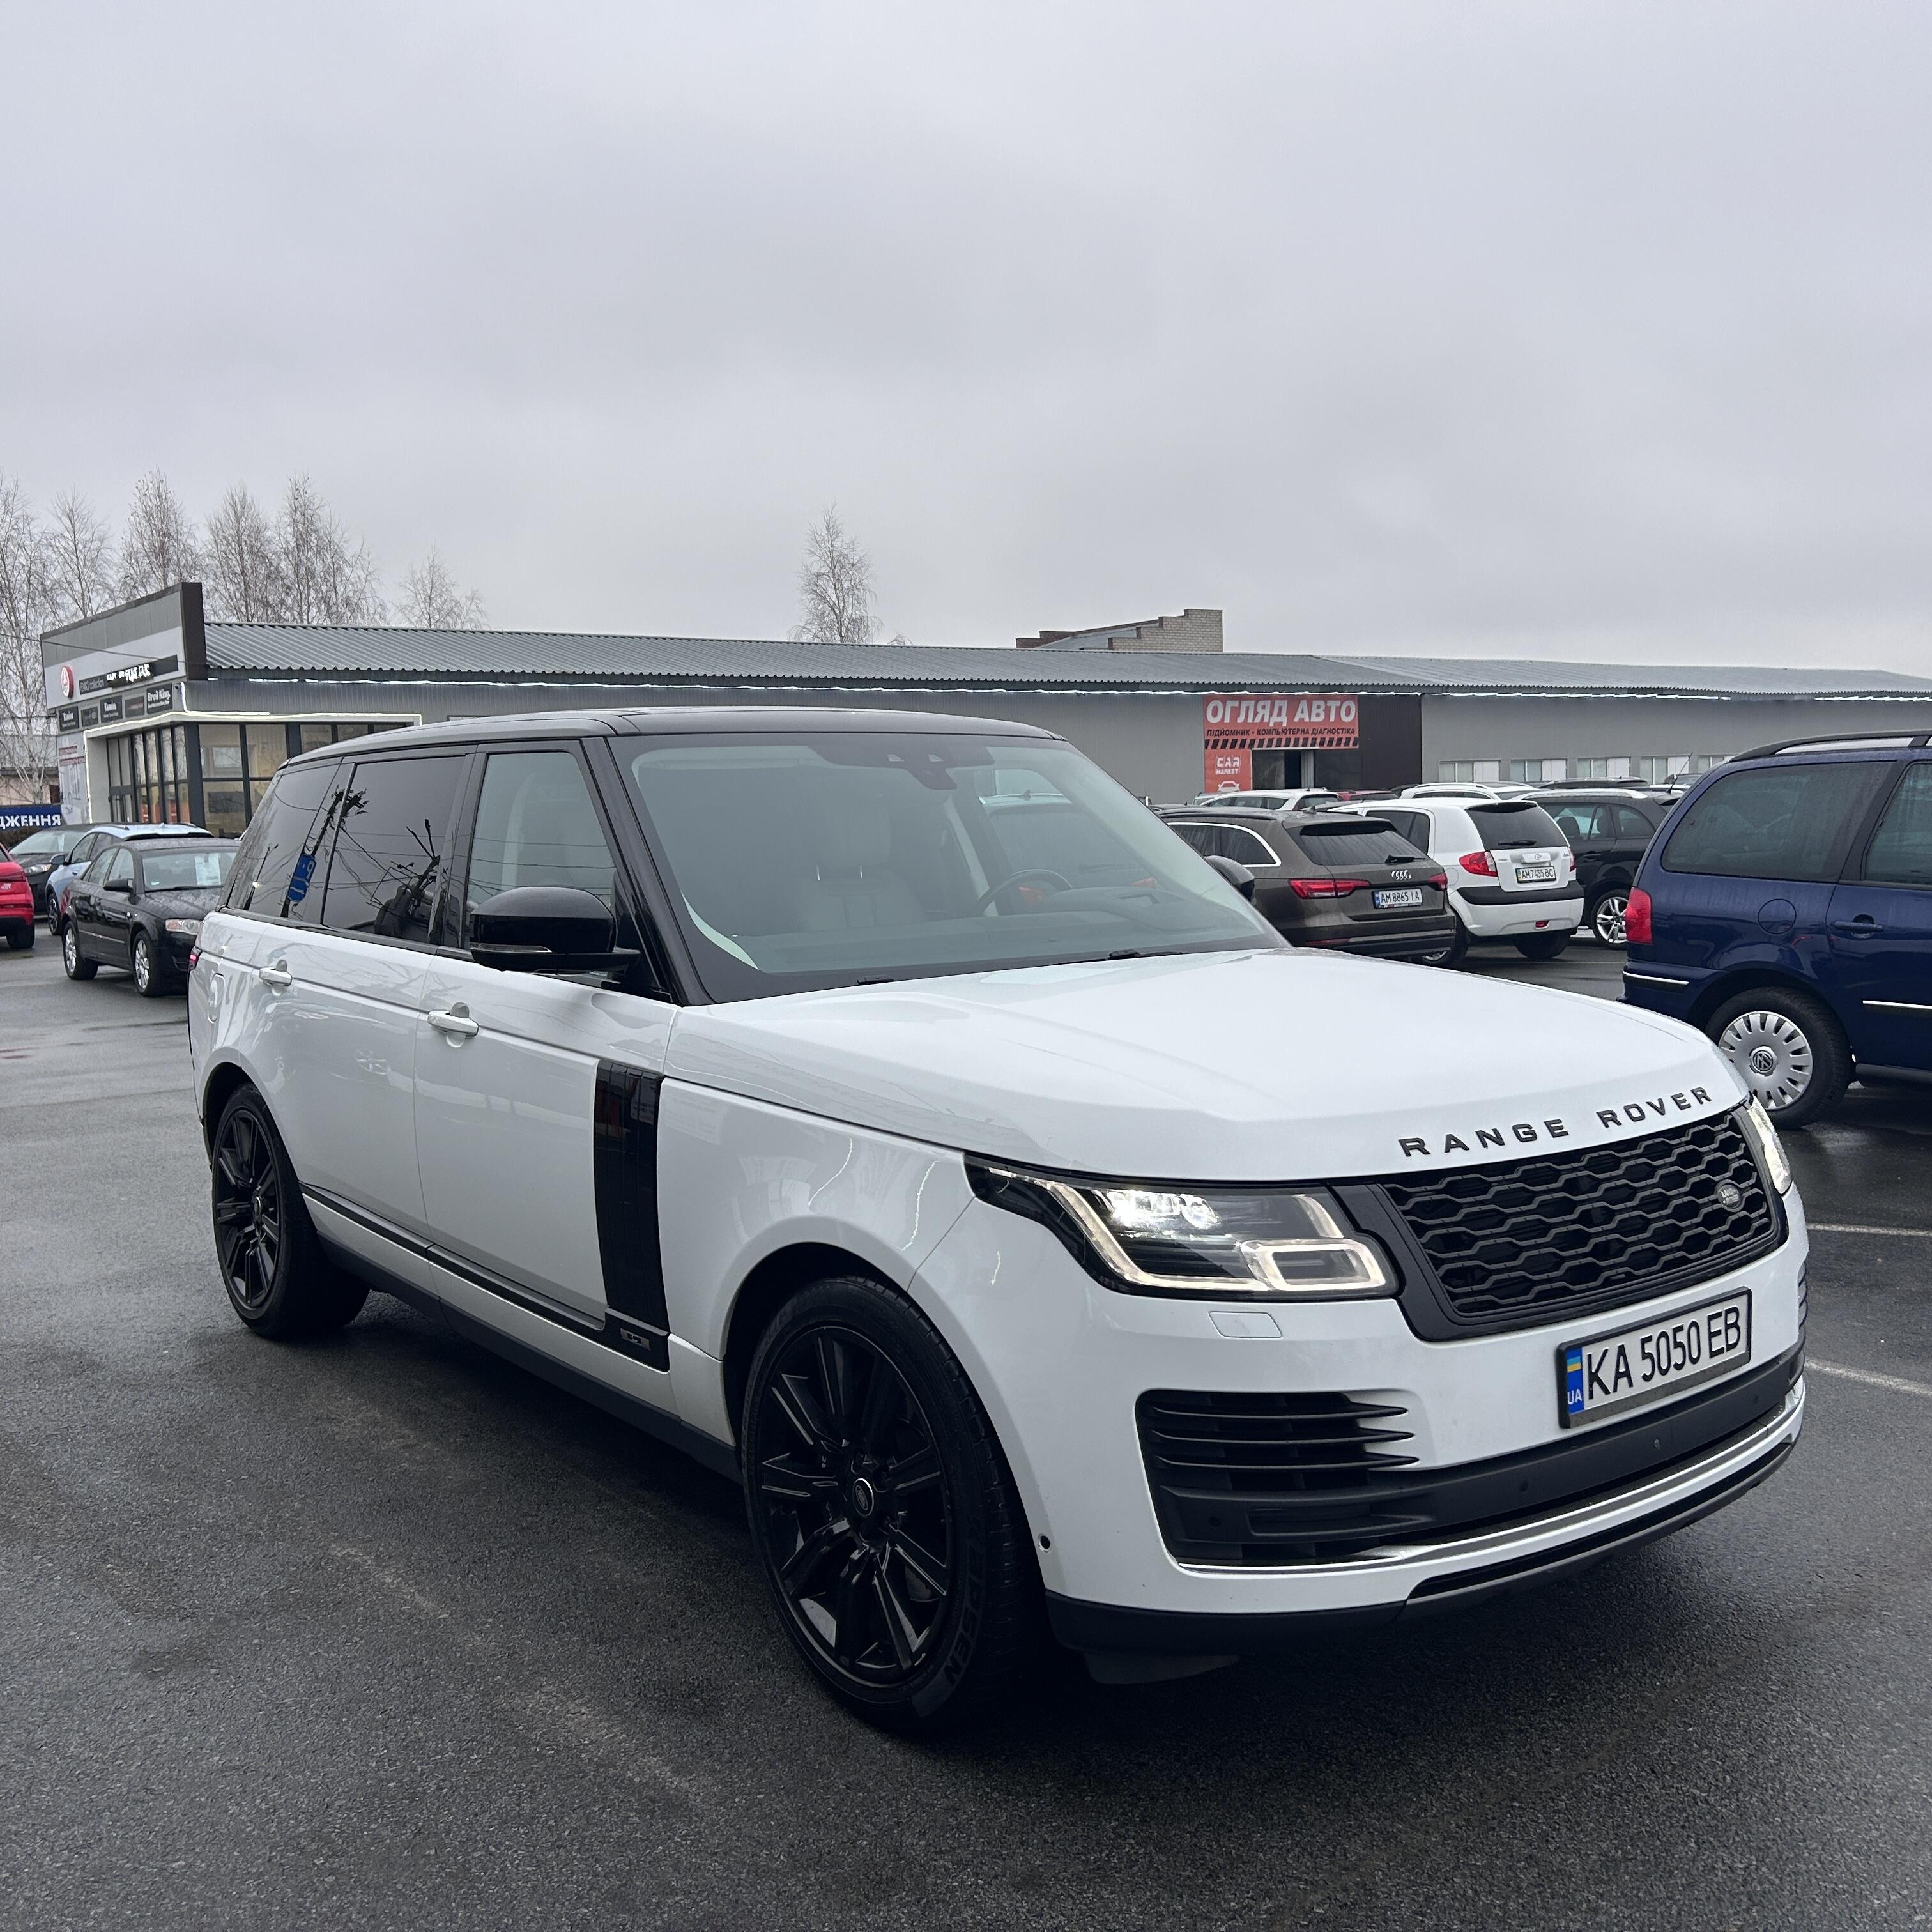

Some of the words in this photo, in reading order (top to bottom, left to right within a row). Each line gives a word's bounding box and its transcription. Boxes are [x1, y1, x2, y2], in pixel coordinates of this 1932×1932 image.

[1206, 700, 1288, 727] ОГЛЯД
[1293, 700, 1356, 723] АВТО
[1206, 727, 1250, 737] ПІДЙОМНИК
[1216, 756, 1240, 767] CAR
[1381, 892, 1392, 903] AM
[1392, 891, 1409, 903] 8865
[1399, 1119, 1569, 1157] RANGE
[1596, 1087, 1712, 1129] ROVER
[1587, 1343, 1634, 1400] KA
[1640, 1320, 1701, 1383] 5050
[1707, 1305, 1741, 1359] EB
[1567, 1388, 1583, 1405] UA
